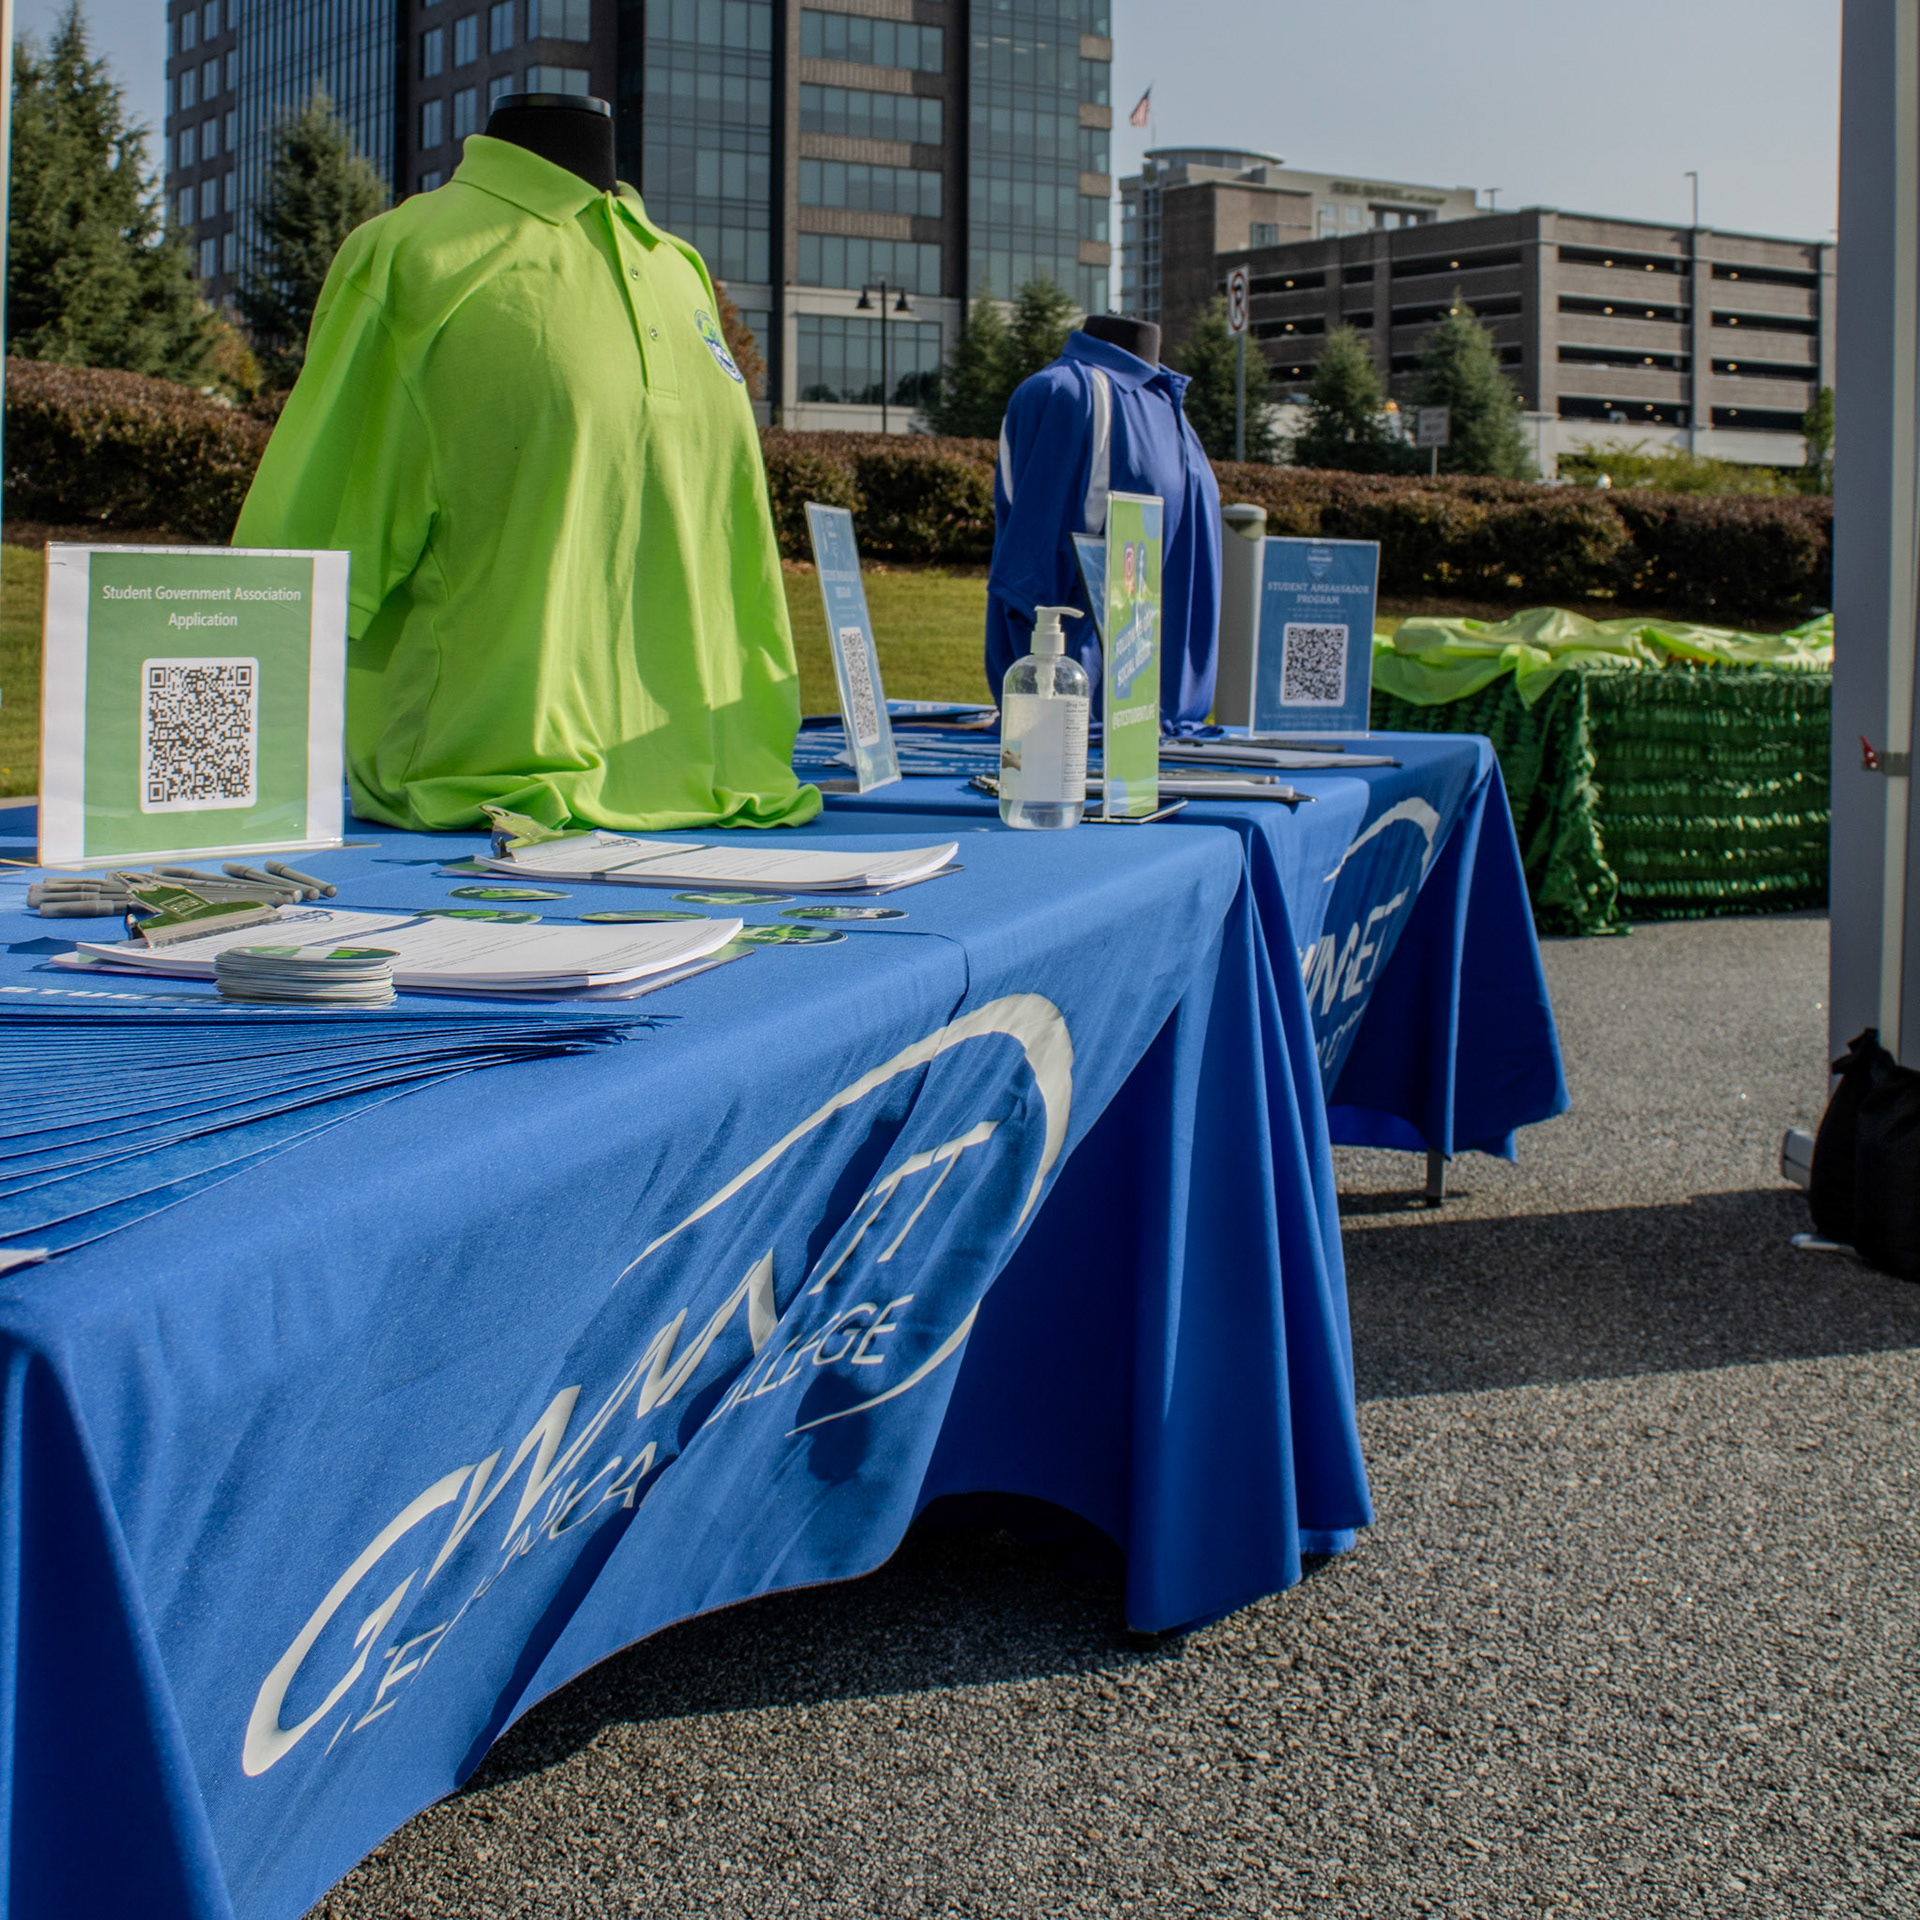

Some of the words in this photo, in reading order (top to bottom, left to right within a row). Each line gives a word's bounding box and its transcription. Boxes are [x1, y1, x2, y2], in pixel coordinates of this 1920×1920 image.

[102, 584, 153, 600] Student
[155, 585, 232, 601] Government
[233, 587, 302, 601] Association
[1267, 581, 1309, 592] STUDENT
[1309, 583, 1370, 594] AMBASSADOR
[1296, 594, 1341, 605] PROGRAM
[168, 612, 238, 630] Application
